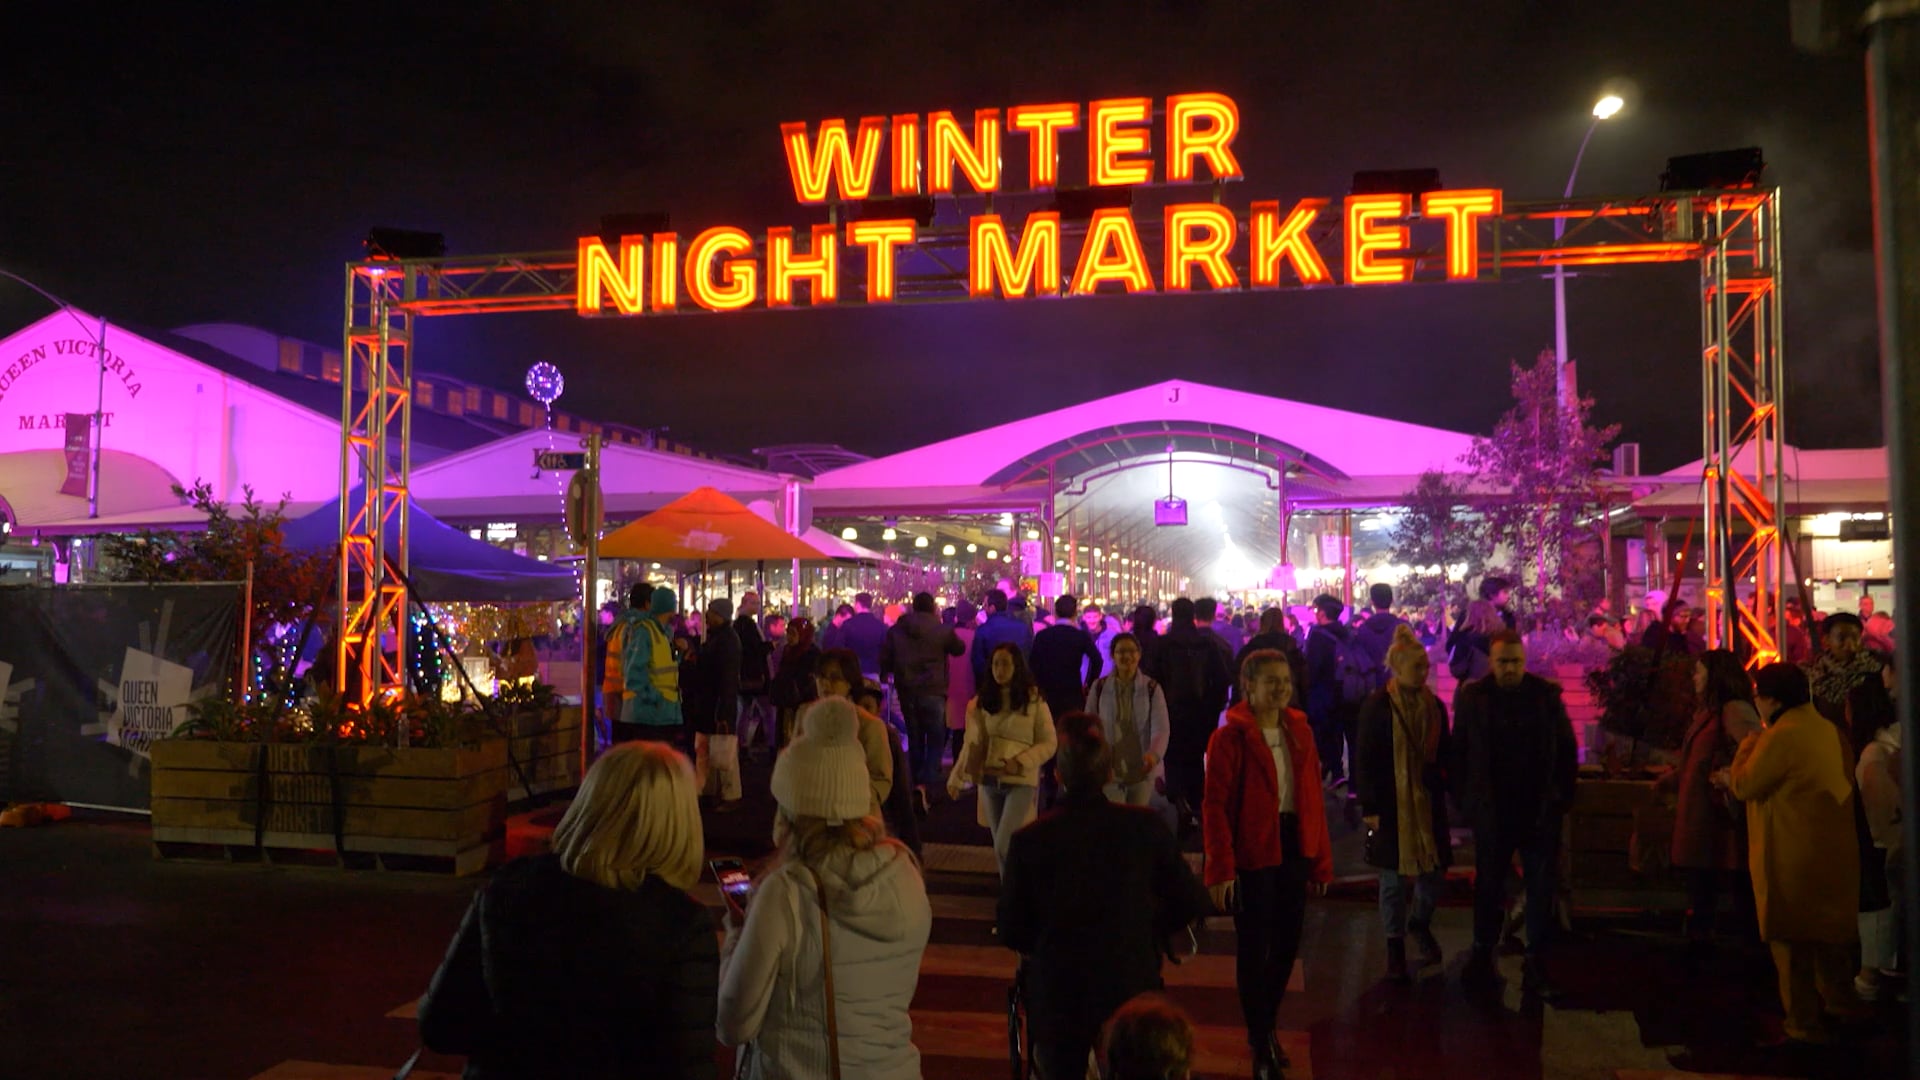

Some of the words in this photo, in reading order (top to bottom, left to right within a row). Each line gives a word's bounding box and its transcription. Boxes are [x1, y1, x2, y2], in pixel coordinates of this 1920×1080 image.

[780, 92, 1243, 203] WINTER
[577, 218, 917, 316] NIGHT
[969, 189, 1503, 299] MARKET
[0, 344, 47, 400] UEEN
[53, 339, 142, 399] VICTORIA
[1167, 387, 1181, 404] J
[18, 412, 115, 430] MARET
[1313, 574, 1368, 587] BLAK
[123, 680, 159, 704] QUEEN
[123, 704, 173, 731] VICTORIA
[268, 744, 310, 772] UEEN
[268, 774, 332, 803] CTORIA
